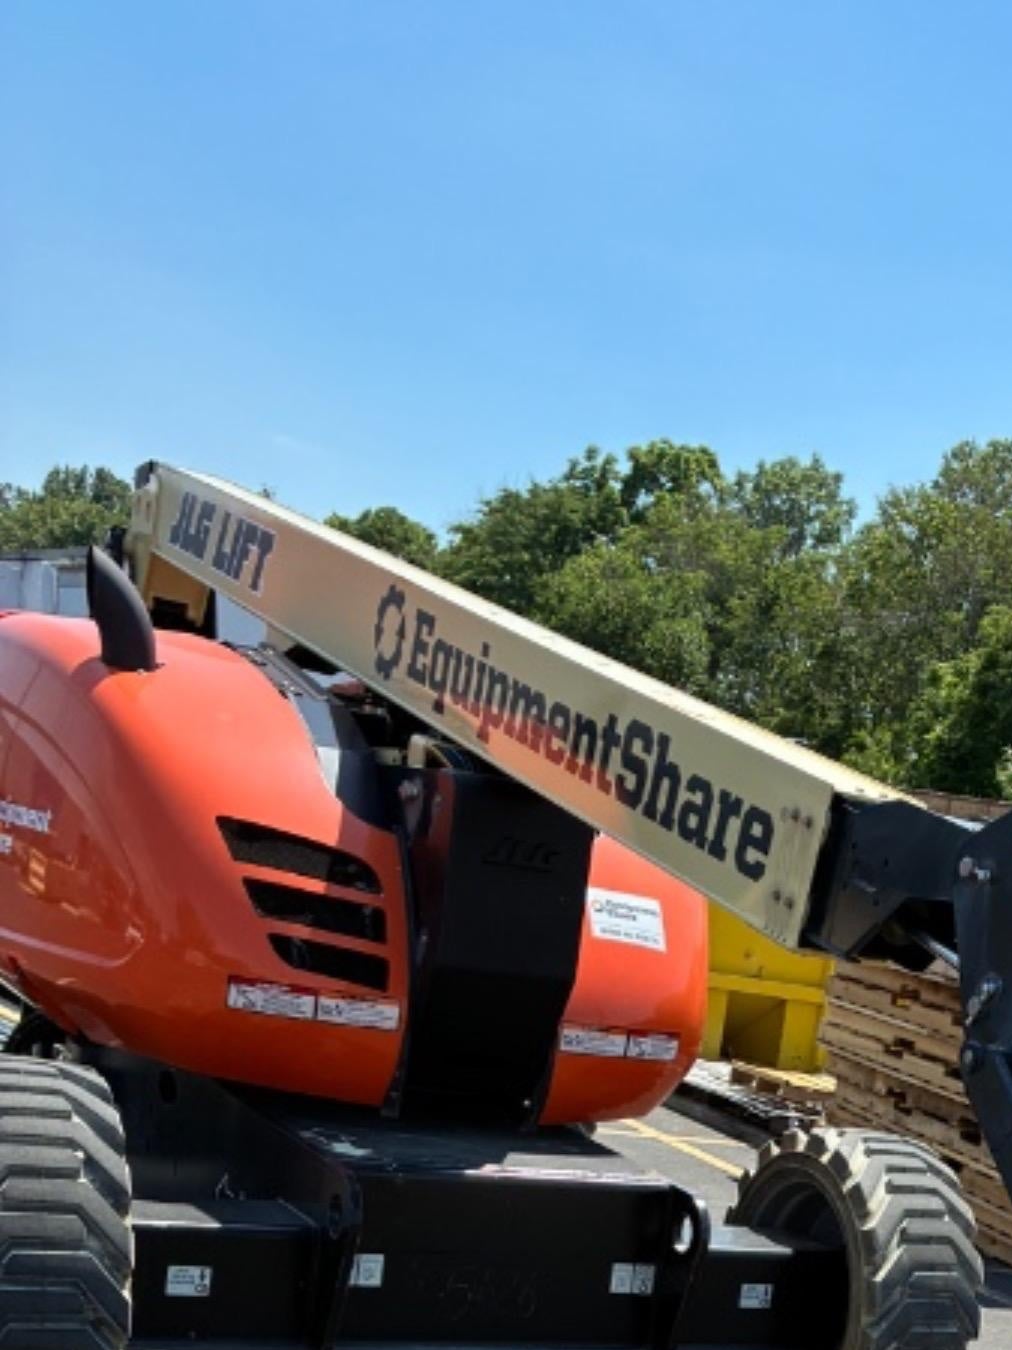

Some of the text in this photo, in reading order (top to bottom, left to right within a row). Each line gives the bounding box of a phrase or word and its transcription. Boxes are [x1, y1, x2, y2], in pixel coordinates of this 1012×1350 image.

[169, 491, 277, 592] JLG LIFT
[406, 607, 774, 883] EquipmentShare
